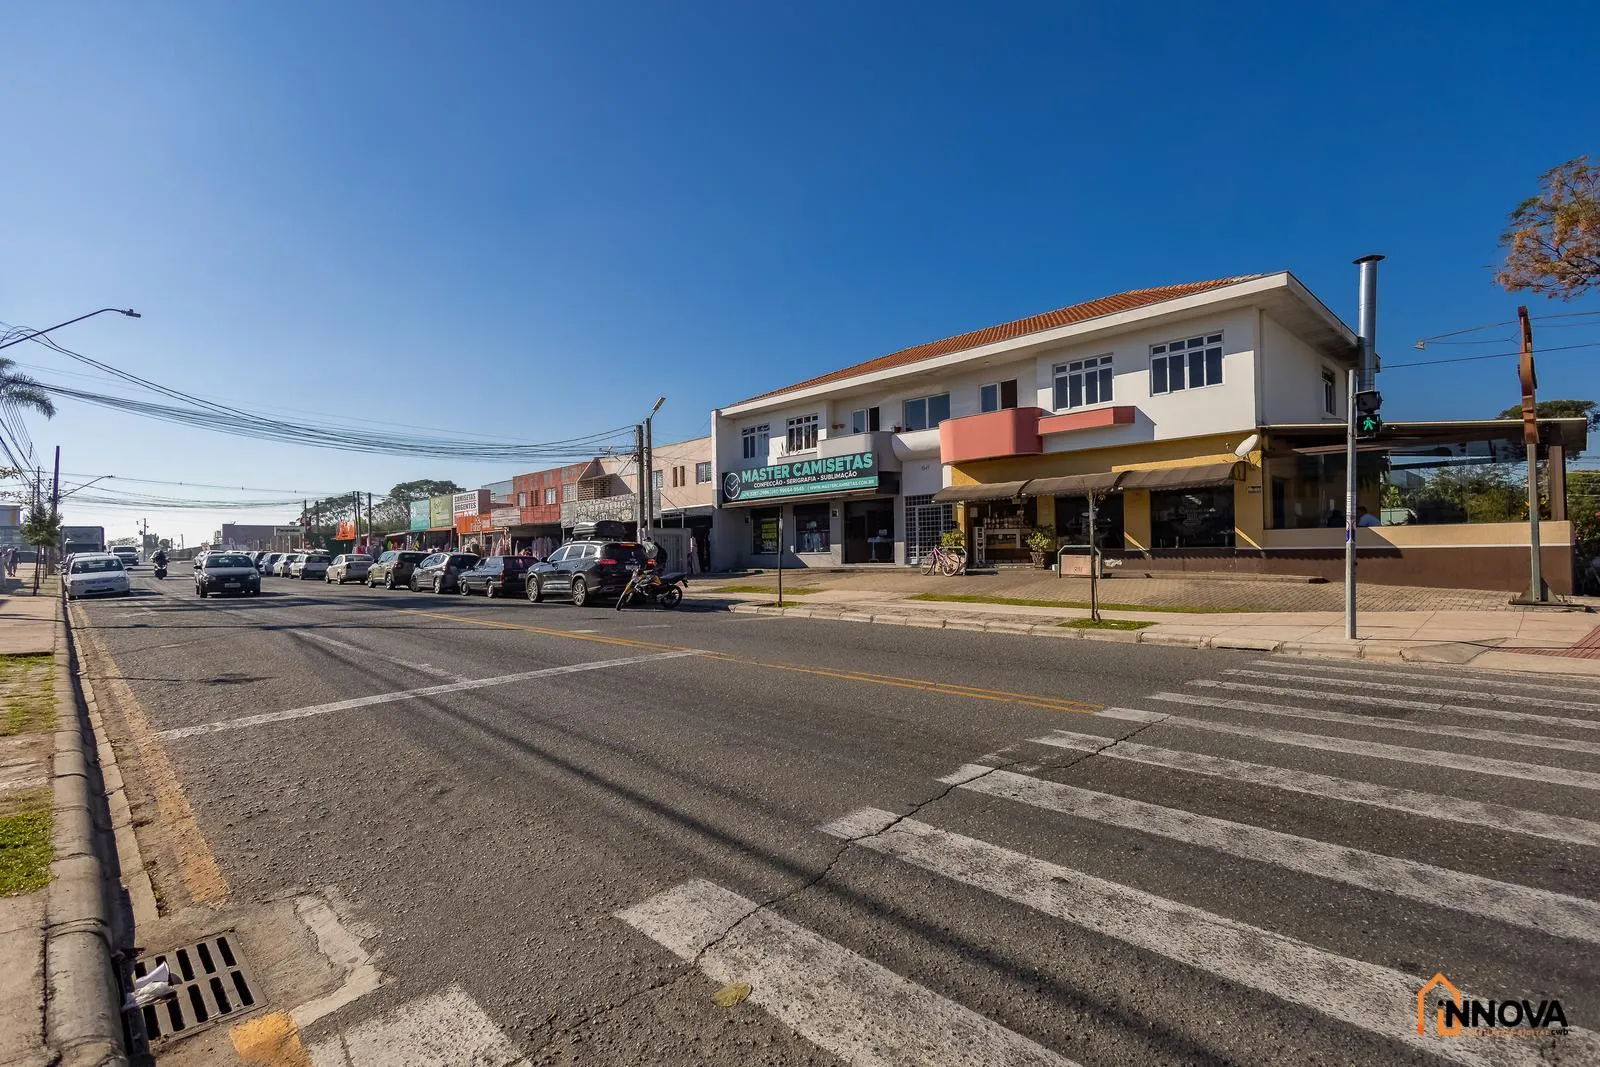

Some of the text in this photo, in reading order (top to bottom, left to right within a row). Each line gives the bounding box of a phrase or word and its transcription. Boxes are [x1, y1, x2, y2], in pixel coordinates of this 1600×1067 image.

[742, 453, 873, 483] MASTER CAMISETAS
[754, 470, 858, 488] CONFECÇÃO SERIGRAFIA SUBLIMAÇÃO
